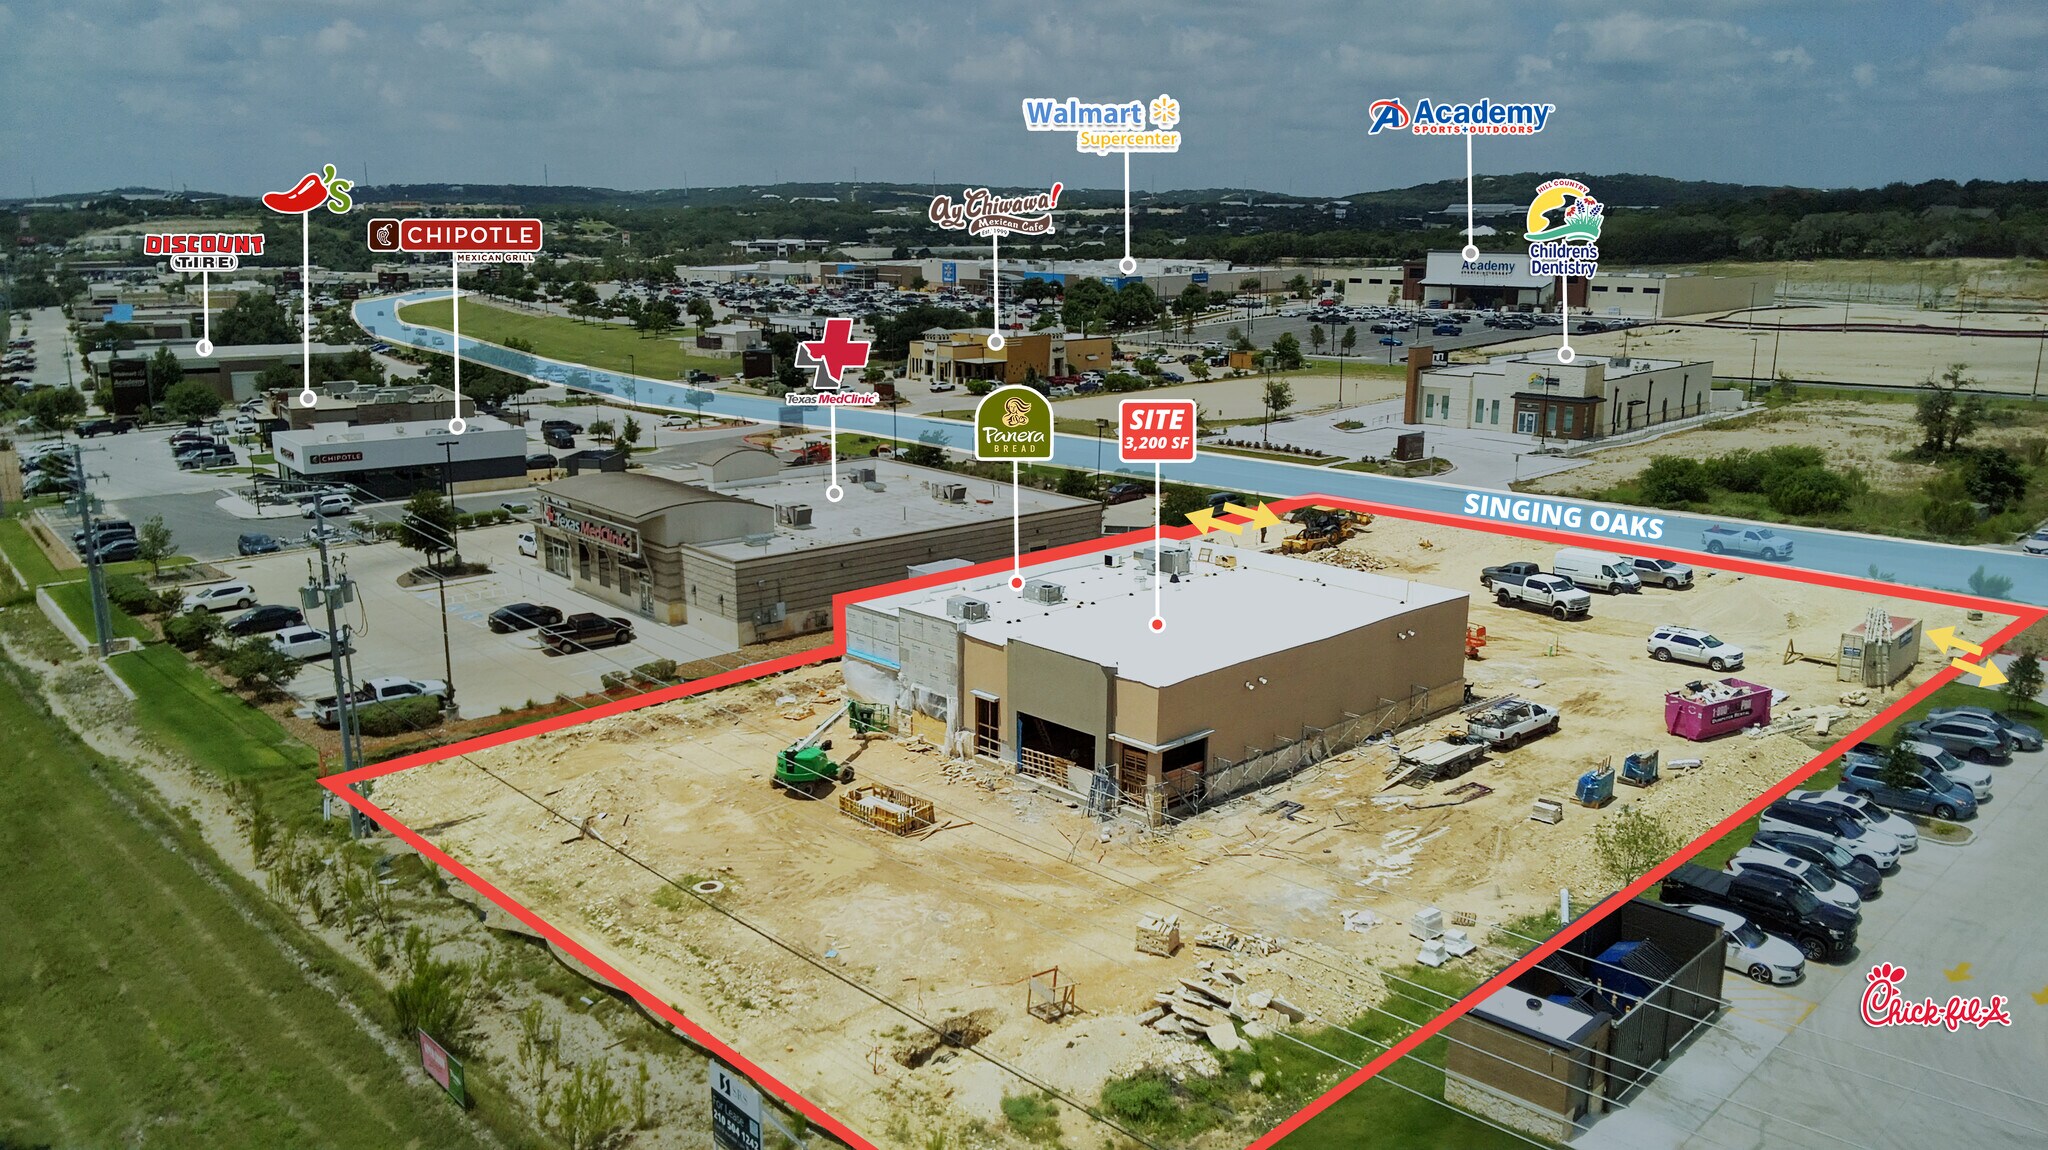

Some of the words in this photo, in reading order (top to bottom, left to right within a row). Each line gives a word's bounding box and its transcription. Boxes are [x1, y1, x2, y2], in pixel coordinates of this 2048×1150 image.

[1461, 260, 1516, 275] Academy
[321, 453, 362, 462] CHIPOTLE
[555, 512, 580, 533] Texas
[580, 520, 631, 548] MedClinic
[712, 1094, 724, 1111] For
[724, 1103, 745, 1127] Lease
[713, 1108, 726, 1126] 210
[727, 1118, 740, 1137] 504
[741, 1131, 759, 1150] 1242
